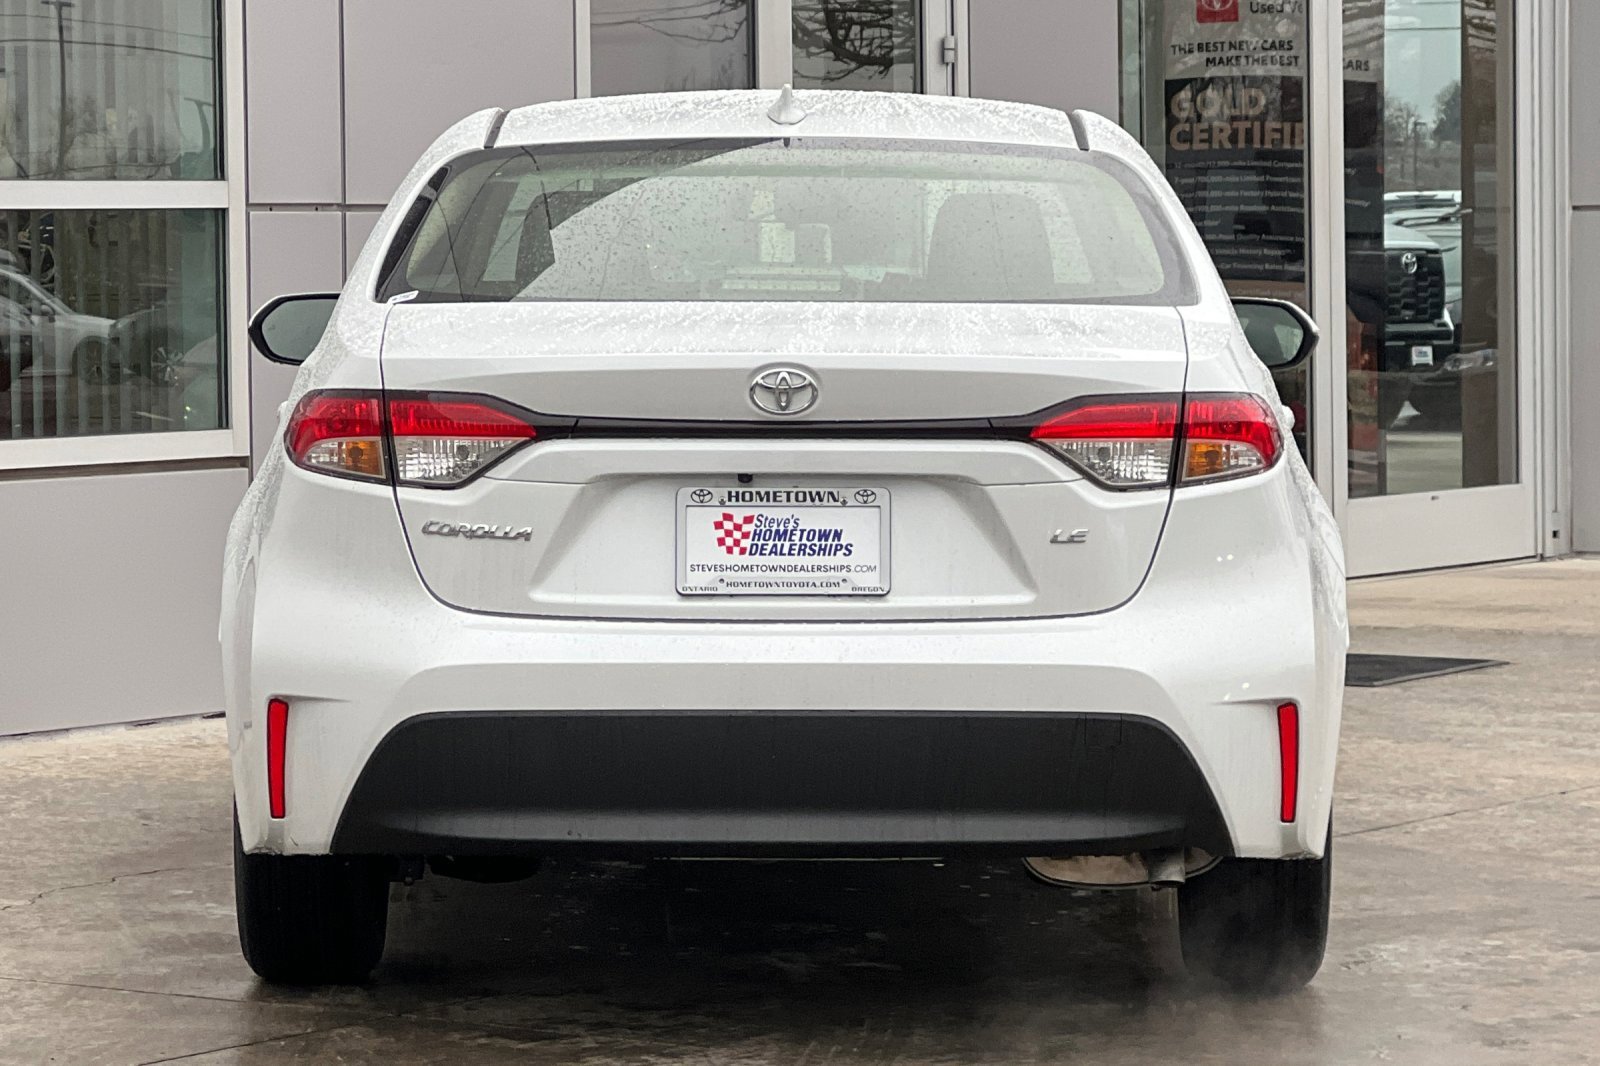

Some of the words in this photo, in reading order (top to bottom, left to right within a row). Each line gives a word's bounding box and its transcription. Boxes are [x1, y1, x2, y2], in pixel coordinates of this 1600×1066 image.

[1249, 1, 1284, 14] Used
[1171, 43, 1194, 55] THE
[1197, 41, 1225, 52] BEST
[1261, 40, 1293, 51] CARS
[1205, 56, 1241, 67] MAKE
[1243, 56, 1268, 66] THE
[1171, 87, 1265, 118] GOLD
[727, 490, 840, 503] HOMETOWN
[754, 513, 800, 529] Steve's
[421, 520, 533, 542] COROLLA
[751, 529, 843, 542] HOMETOWN
[1049, 528, 1090, 544] LE
[748, 543, 853, 557] DEALERSHIPS
[726, 581, 841, 589] HOMETOWNTOYOTA.COM
